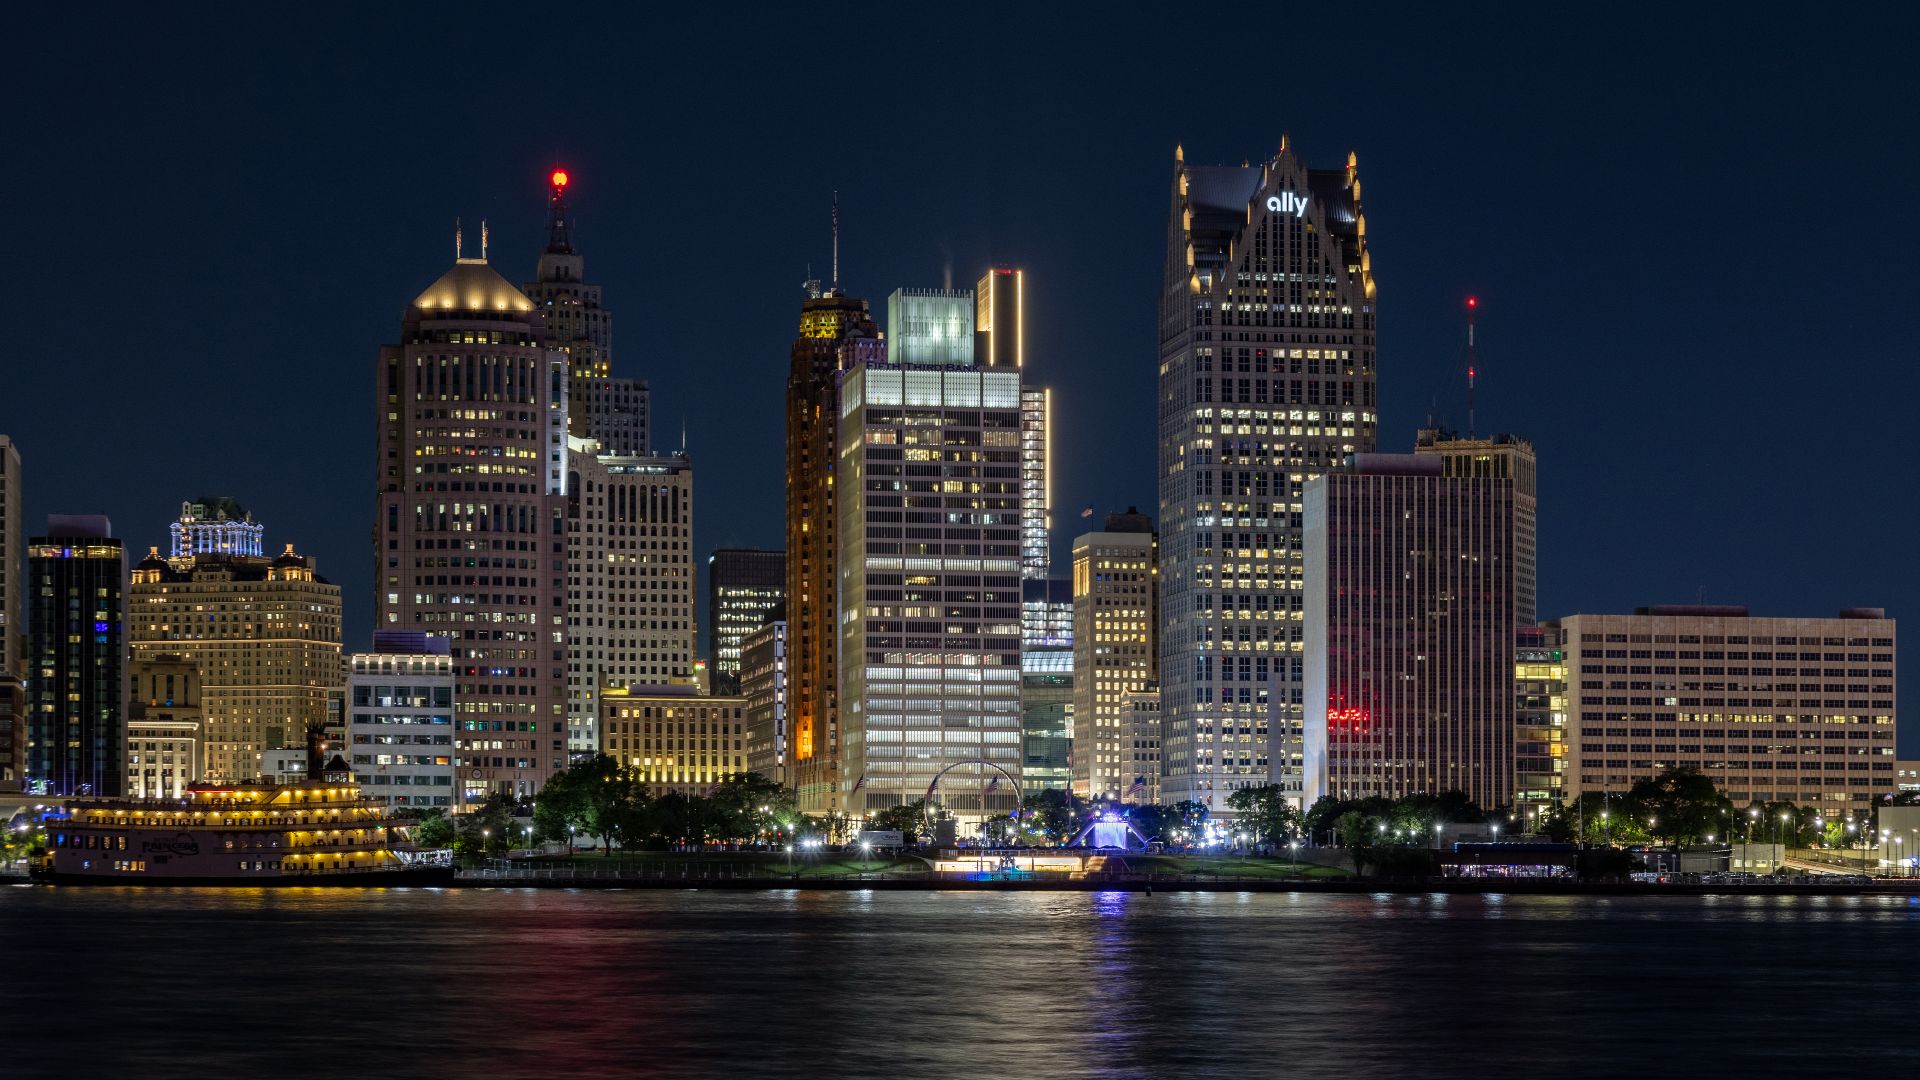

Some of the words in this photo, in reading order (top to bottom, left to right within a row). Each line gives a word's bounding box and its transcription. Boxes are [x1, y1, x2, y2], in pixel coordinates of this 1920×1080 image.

[1266, 191, 1309, 218] ally
[866, 361, 900, 370] FIFTH
[904, 362, 942, 372] THIRD
[946, 363, 980, 372] BANK
